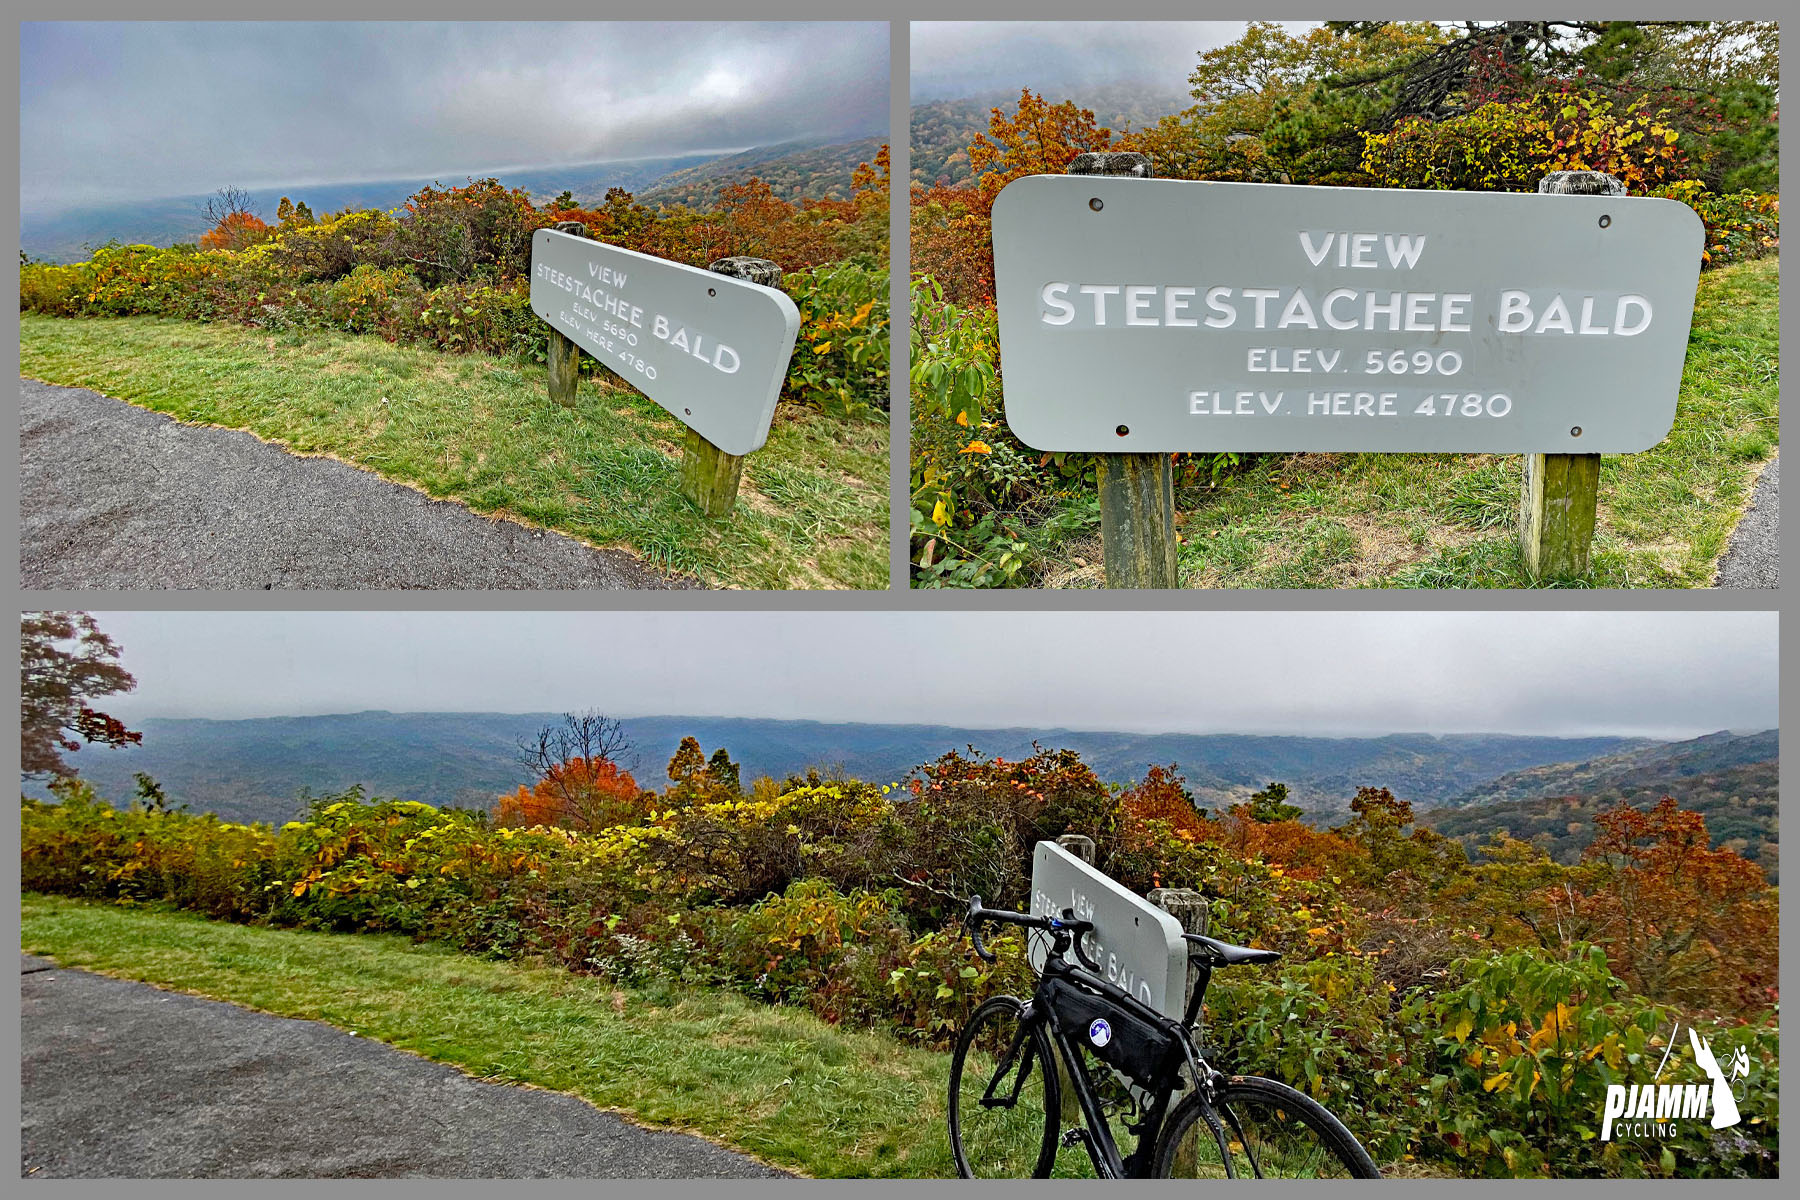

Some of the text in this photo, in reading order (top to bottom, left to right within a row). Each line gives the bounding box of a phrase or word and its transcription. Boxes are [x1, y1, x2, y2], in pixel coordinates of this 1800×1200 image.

[1298, 230, 1426, 270] VIEW
[588, 261, 627, 289] VIEW
[537, 263, 741, 374] STEESTACHEE BALD
[1041, 281, 1654, 336] STEESTACHEE BALD
[603, 319, 638, 346] 5690
[586, 327, 614, 353] HERE
[618, 351, 657, 380] 4780
[1247, 348, 1463, 376] ELEV. 5690
[1189, 391, 1513, 418] ELEV. HERE 4780
[1071, 888, 1096, 920] VIEW
